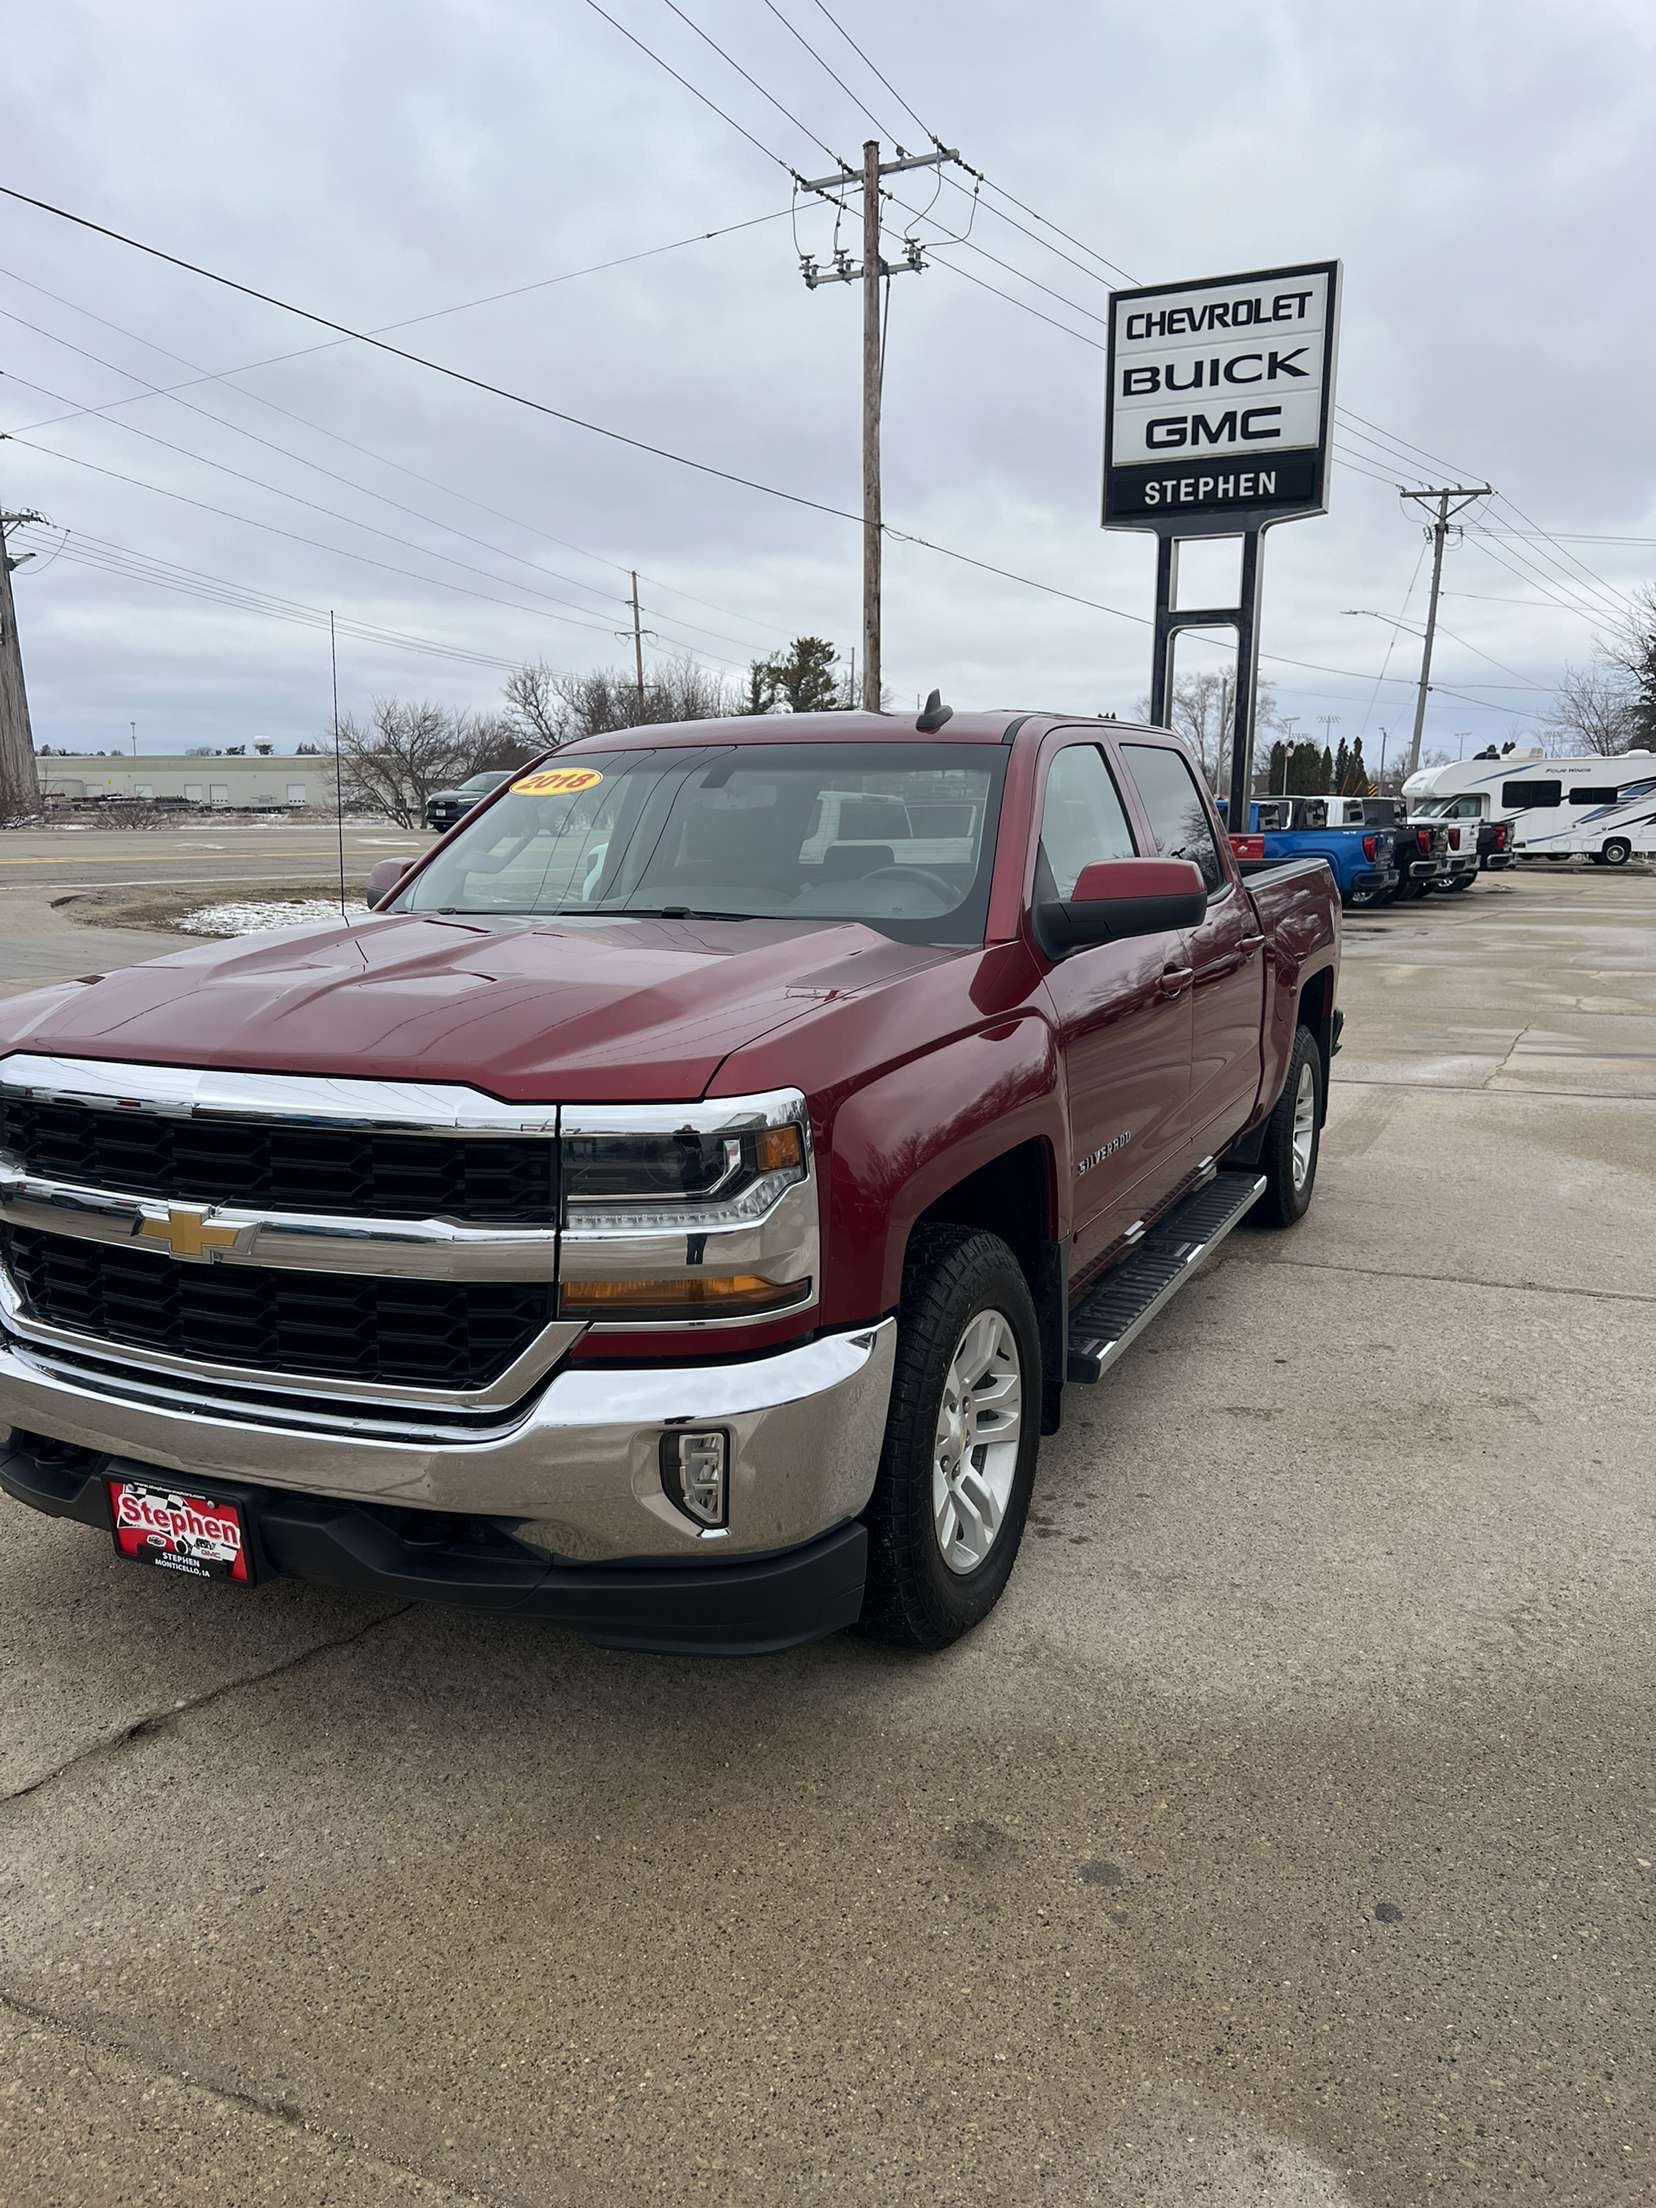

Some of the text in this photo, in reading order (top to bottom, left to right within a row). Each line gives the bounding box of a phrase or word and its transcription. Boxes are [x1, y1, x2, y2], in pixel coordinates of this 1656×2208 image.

[1126, 291, 1313, 340] CHEVROLET
[1123, 347, 1310, 396] BUICK
[1145, 405, 1282, 449] GMC
[1144, 471, 1276, 505] STEPHEN
[516, 773, 596, 790] 2018
[1079, 1130, 1131, 1176] SILVERADO
[120, 1497, 238, 1546] Stephen
[155, 1558, 201, 1576] MONTICELLO,
[162, 1552, 200, 1568] STEPHEN
